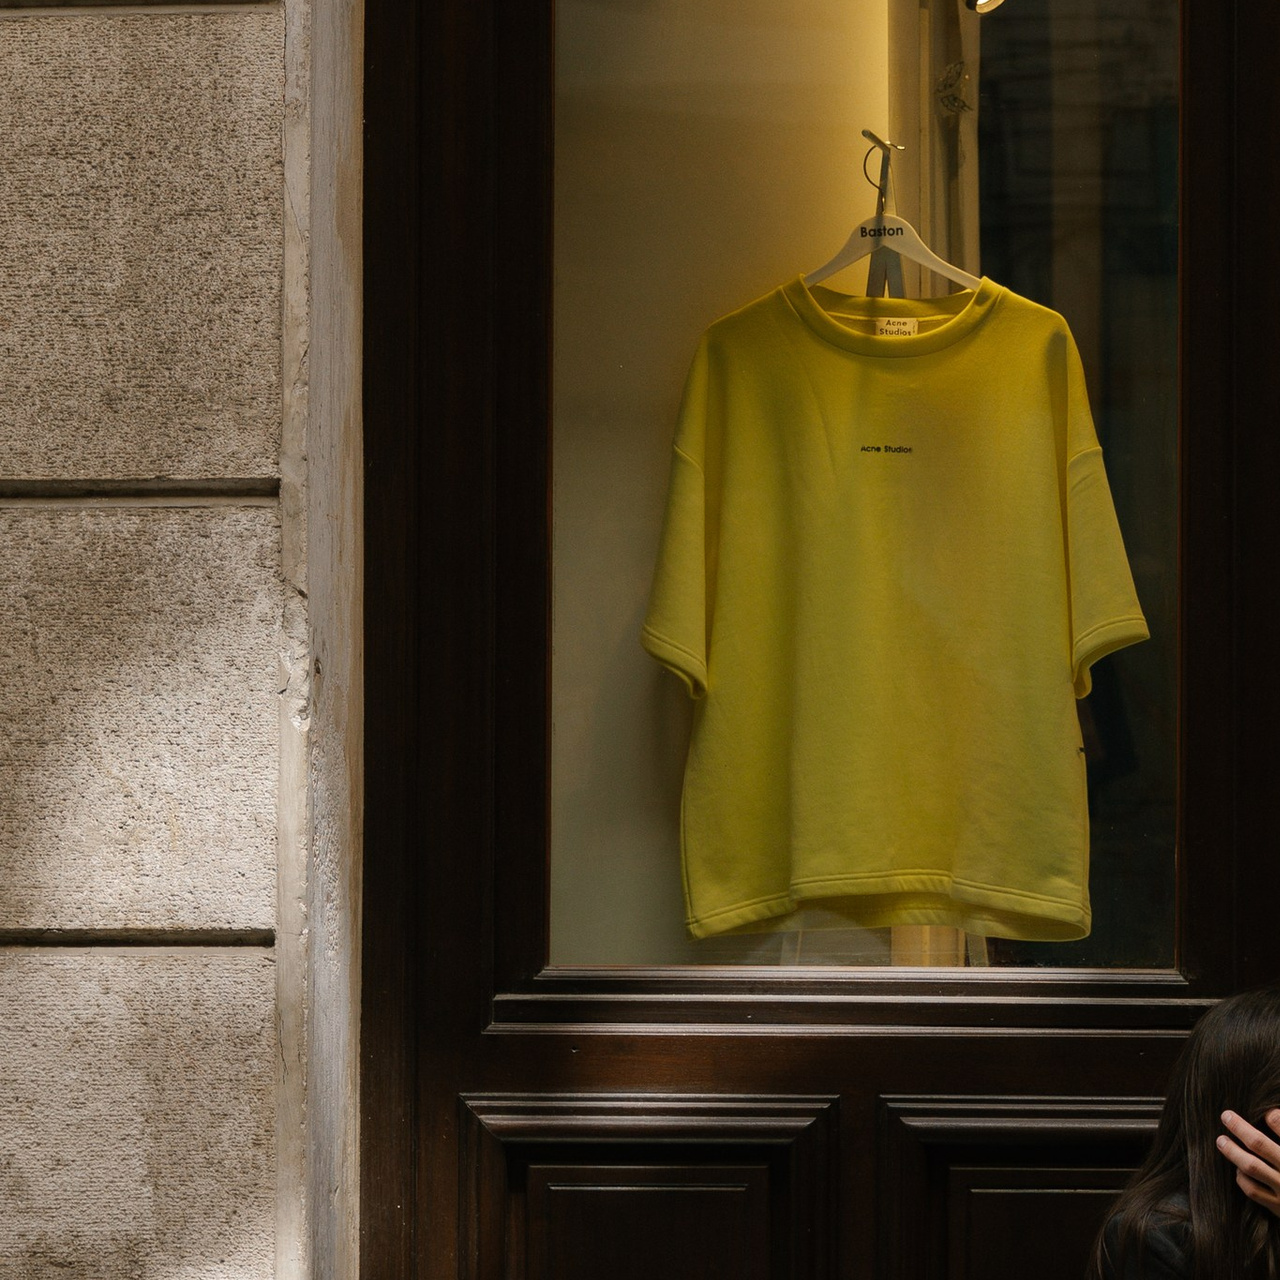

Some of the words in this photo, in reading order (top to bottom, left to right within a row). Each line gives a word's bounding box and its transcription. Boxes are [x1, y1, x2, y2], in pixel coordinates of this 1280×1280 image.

[860, 226, 904, 238] Baston
[885, 319, 908, 327] Acne
[860, 445, 881, 453] Acne
